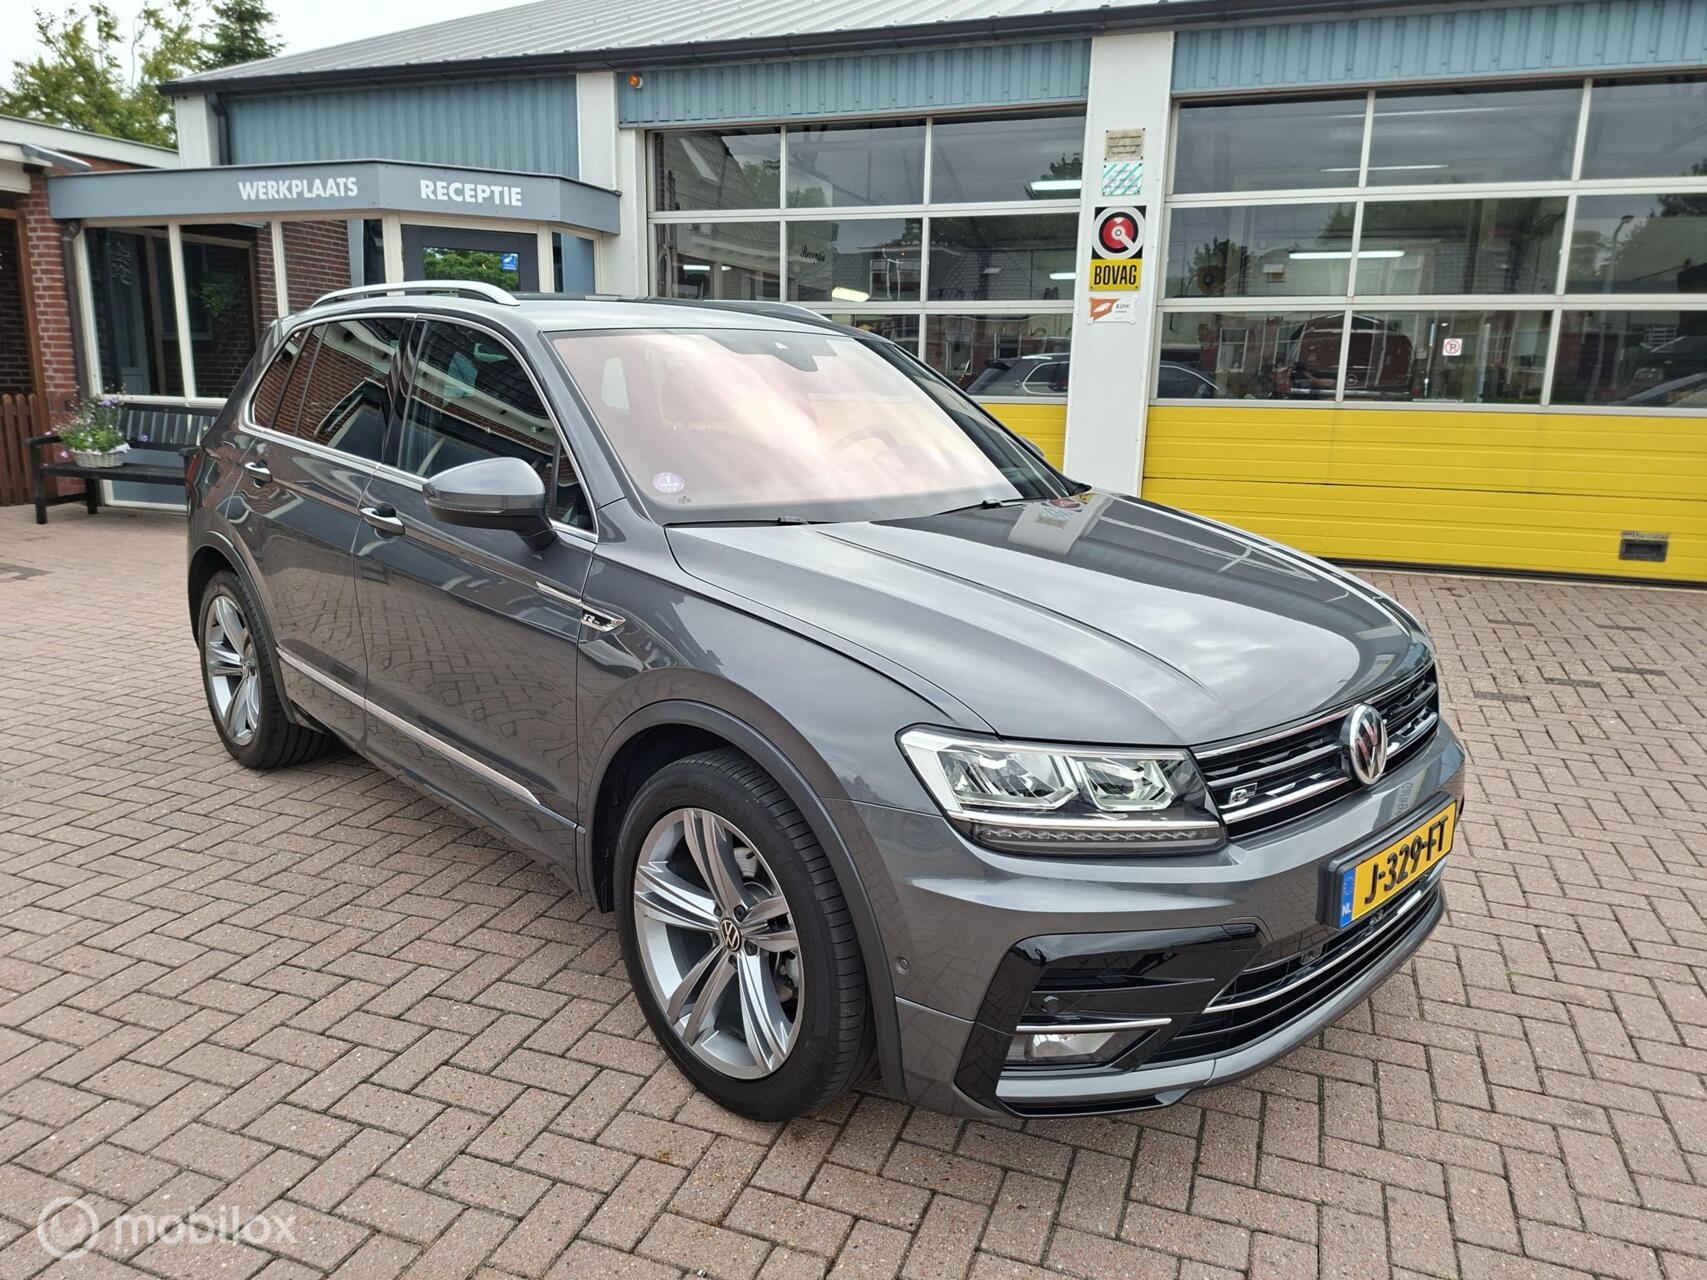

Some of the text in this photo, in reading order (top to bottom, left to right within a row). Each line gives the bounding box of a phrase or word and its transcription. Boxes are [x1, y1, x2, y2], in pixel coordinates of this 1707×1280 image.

[238, 177, 358, 201] WERKPLAATS
[420, 179, 522, 206] RECEPTIE
[1094, 264, 1137, 285] BOVAG
[1364, 814, 1449, 905] J-329-FT
[1342, 902, 1351, 917] NL
